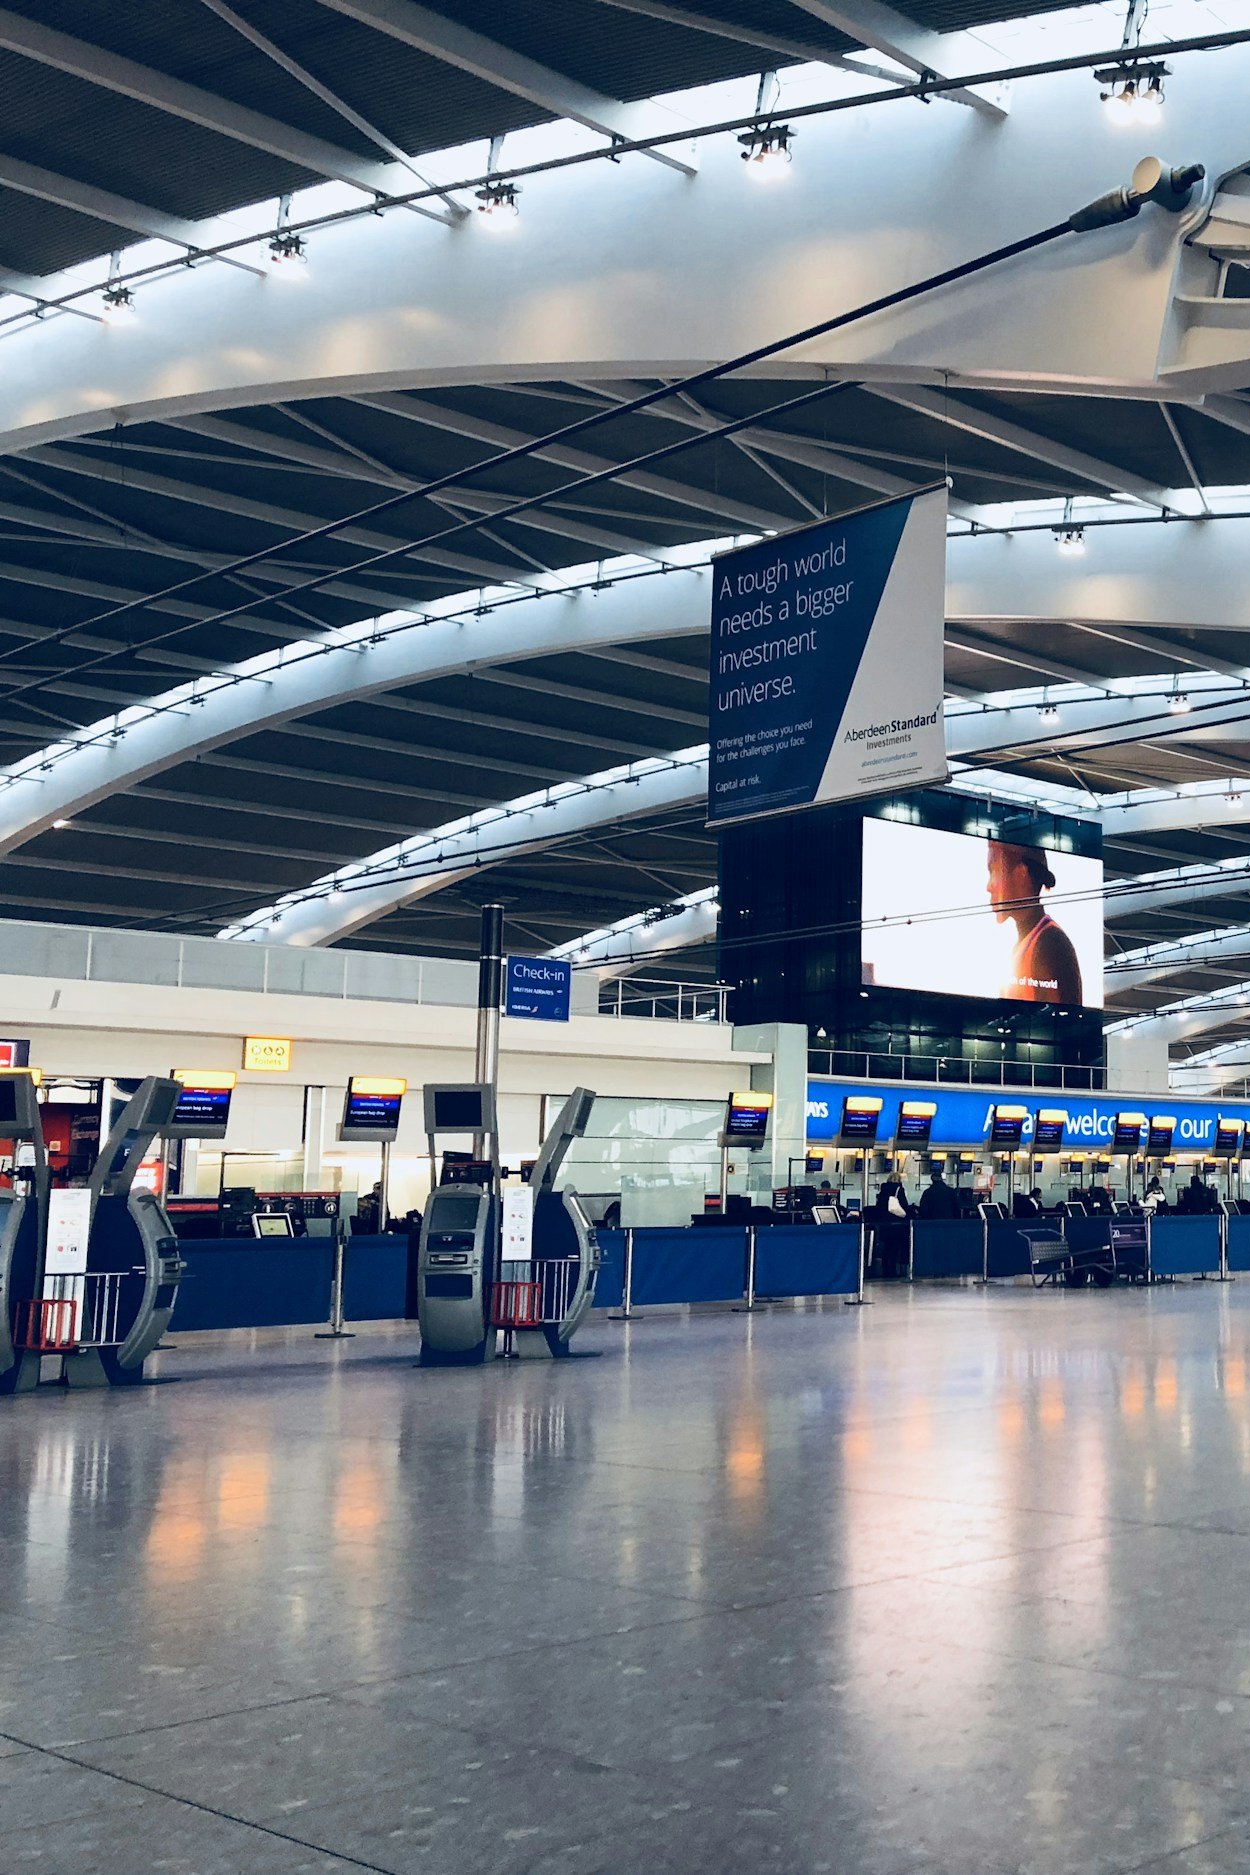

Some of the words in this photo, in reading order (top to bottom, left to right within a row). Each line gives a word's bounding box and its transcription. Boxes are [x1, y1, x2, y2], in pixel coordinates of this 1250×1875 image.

[719, 575, 733, 601] A
[737, 558, 788, 594] tough
[794, 537, 846, 578] world
[720, 600, 773, 637] needs
[778, 600, 789, 621] a
[796, 580, 854, 619] bigger
[719, 627, 817, 675] investment
[718, 674, 796, 712] universe.
[716, 737, 744, 749] Offering
[744, 733, 756, 744] the
[757, 729, 779, 740] choice
[779, 725, 793, 738] you
[794, 718, 813, 731] need
[866, 733, 912, 750] Investments
[716, 753, 726, 763] for
[727, 750, 738, 761] the
[739, 742, 774, 758] challenges
[775, 741, 789, 753] you
[715, 779, 738, 793] Capital
[739, 779, 746, 788] at
[513, 963, 565, 981] Check-in
[1180, 1118, 1212, 1138] our
